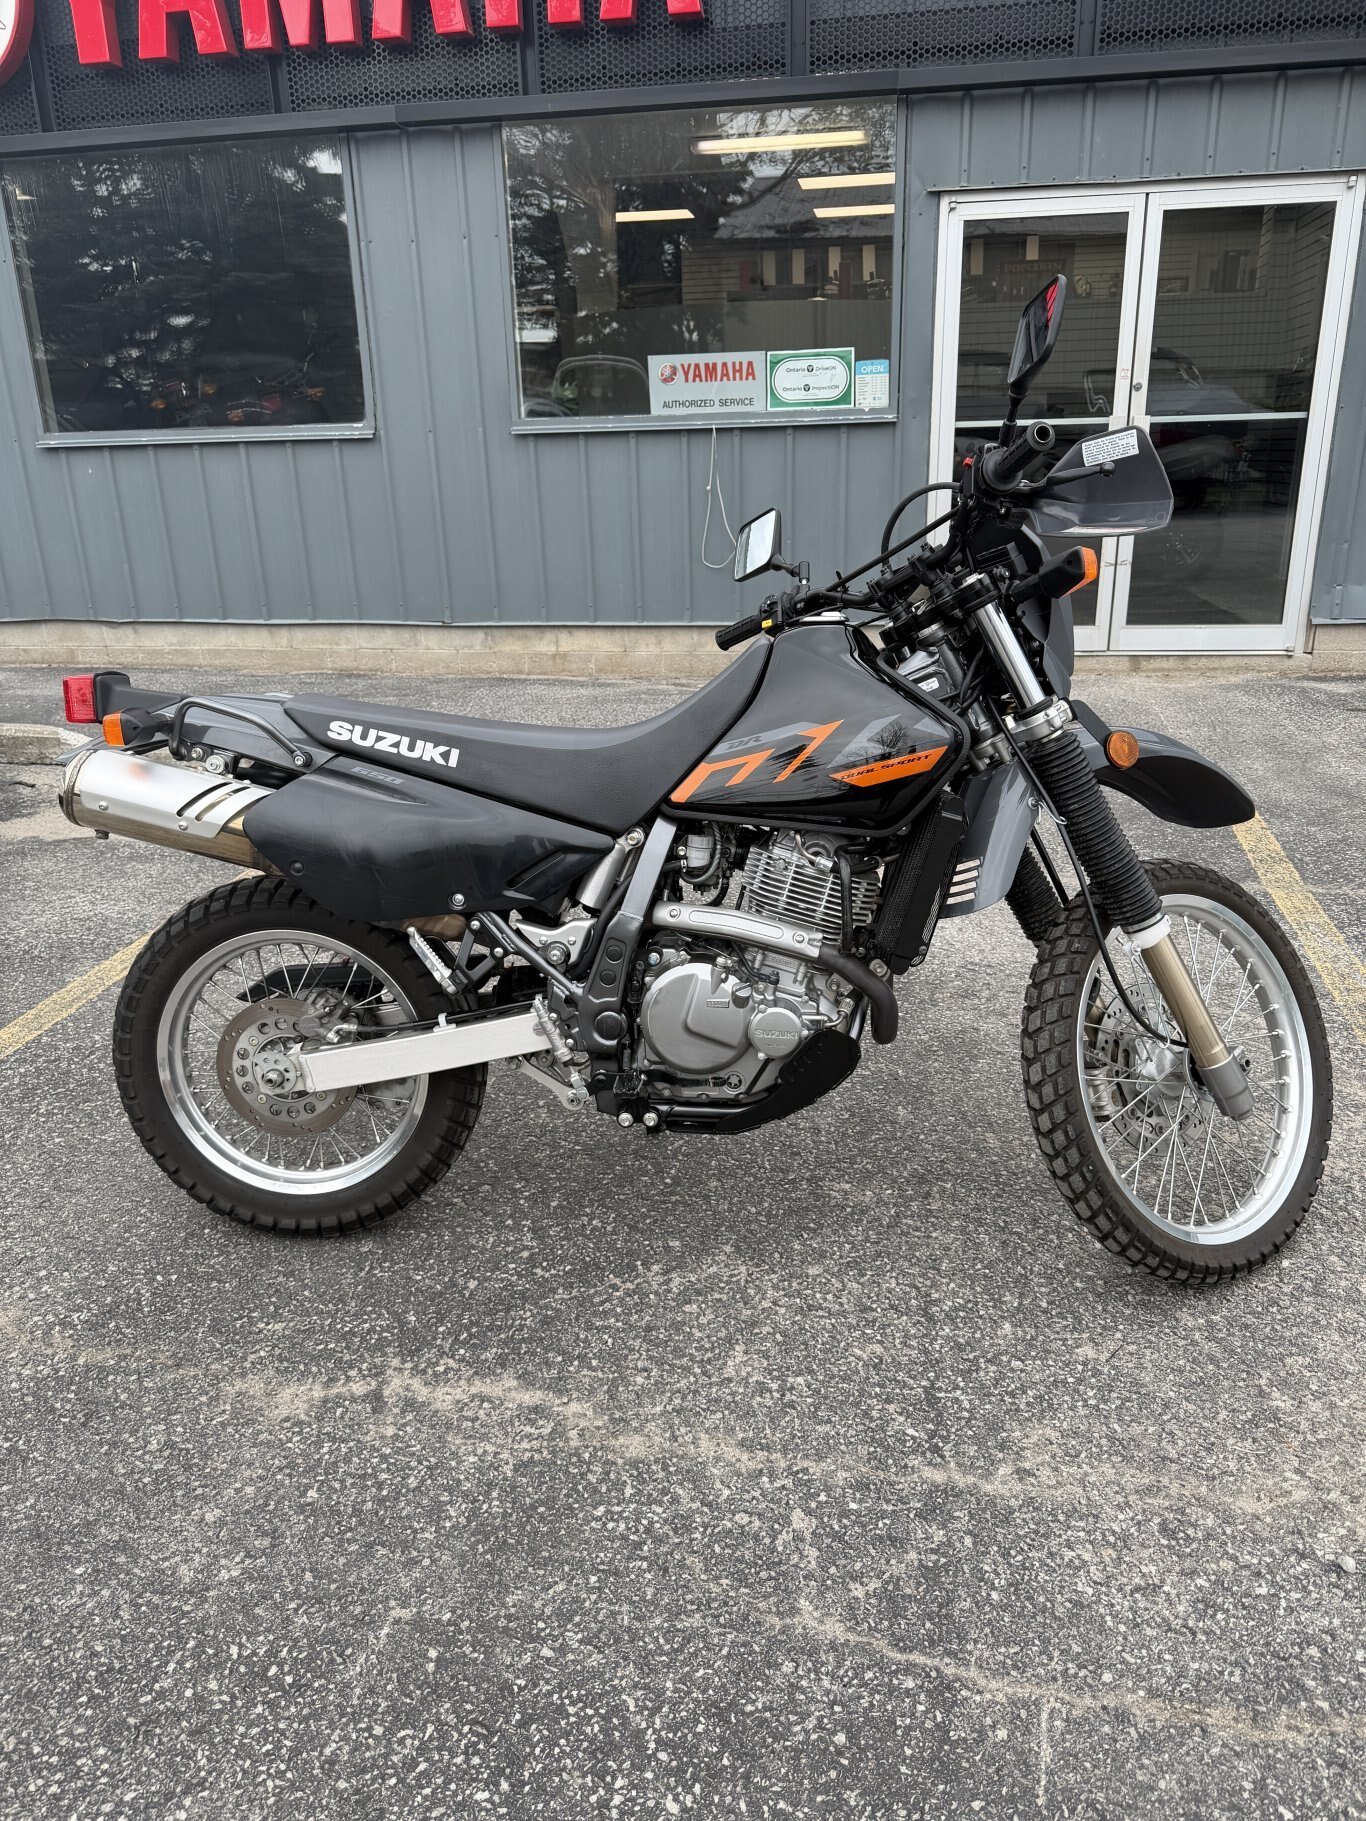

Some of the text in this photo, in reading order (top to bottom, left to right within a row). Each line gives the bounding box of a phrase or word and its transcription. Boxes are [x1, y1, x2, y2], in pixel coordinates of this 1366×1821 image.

[680, 360, 756, 384] YAMAHA
[861, 365, 884, 373] OPEN
[662, 397, 755, 409] AUTHORIZED SERVICE
[327, 720, 460, 768] SUZUKI
[726, 735, 762, 750] DR
[840, 753, 933, 780] DUAL SPORT
[350, 766, 405, 785] 650
[754, 1029, 799, 1040] SUZUKI
